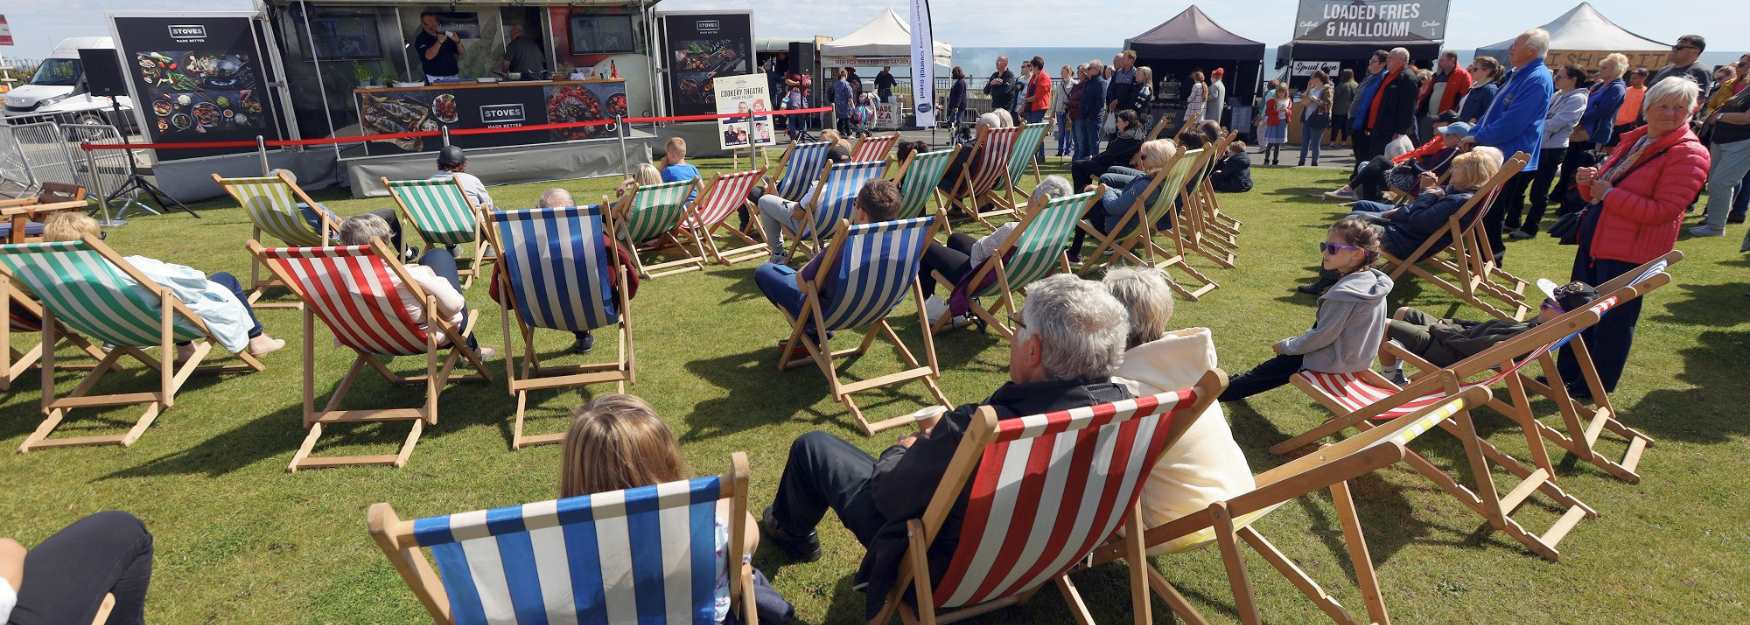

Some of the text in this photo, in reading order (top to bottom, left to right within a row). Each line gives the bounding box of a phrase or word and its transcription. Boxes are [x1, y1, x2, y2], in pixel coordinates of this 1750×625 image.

[1323, 3, 1420, 20] LOADED FRIES
[1326, 21, 1336, 37] &
[1338, 21, 1410, 37] HALLOUMI
[721, 89, 743, 98] COOKERY
[743, 86, 764, 96] THEATRE
[484, 109, 521, 118] STOVES
